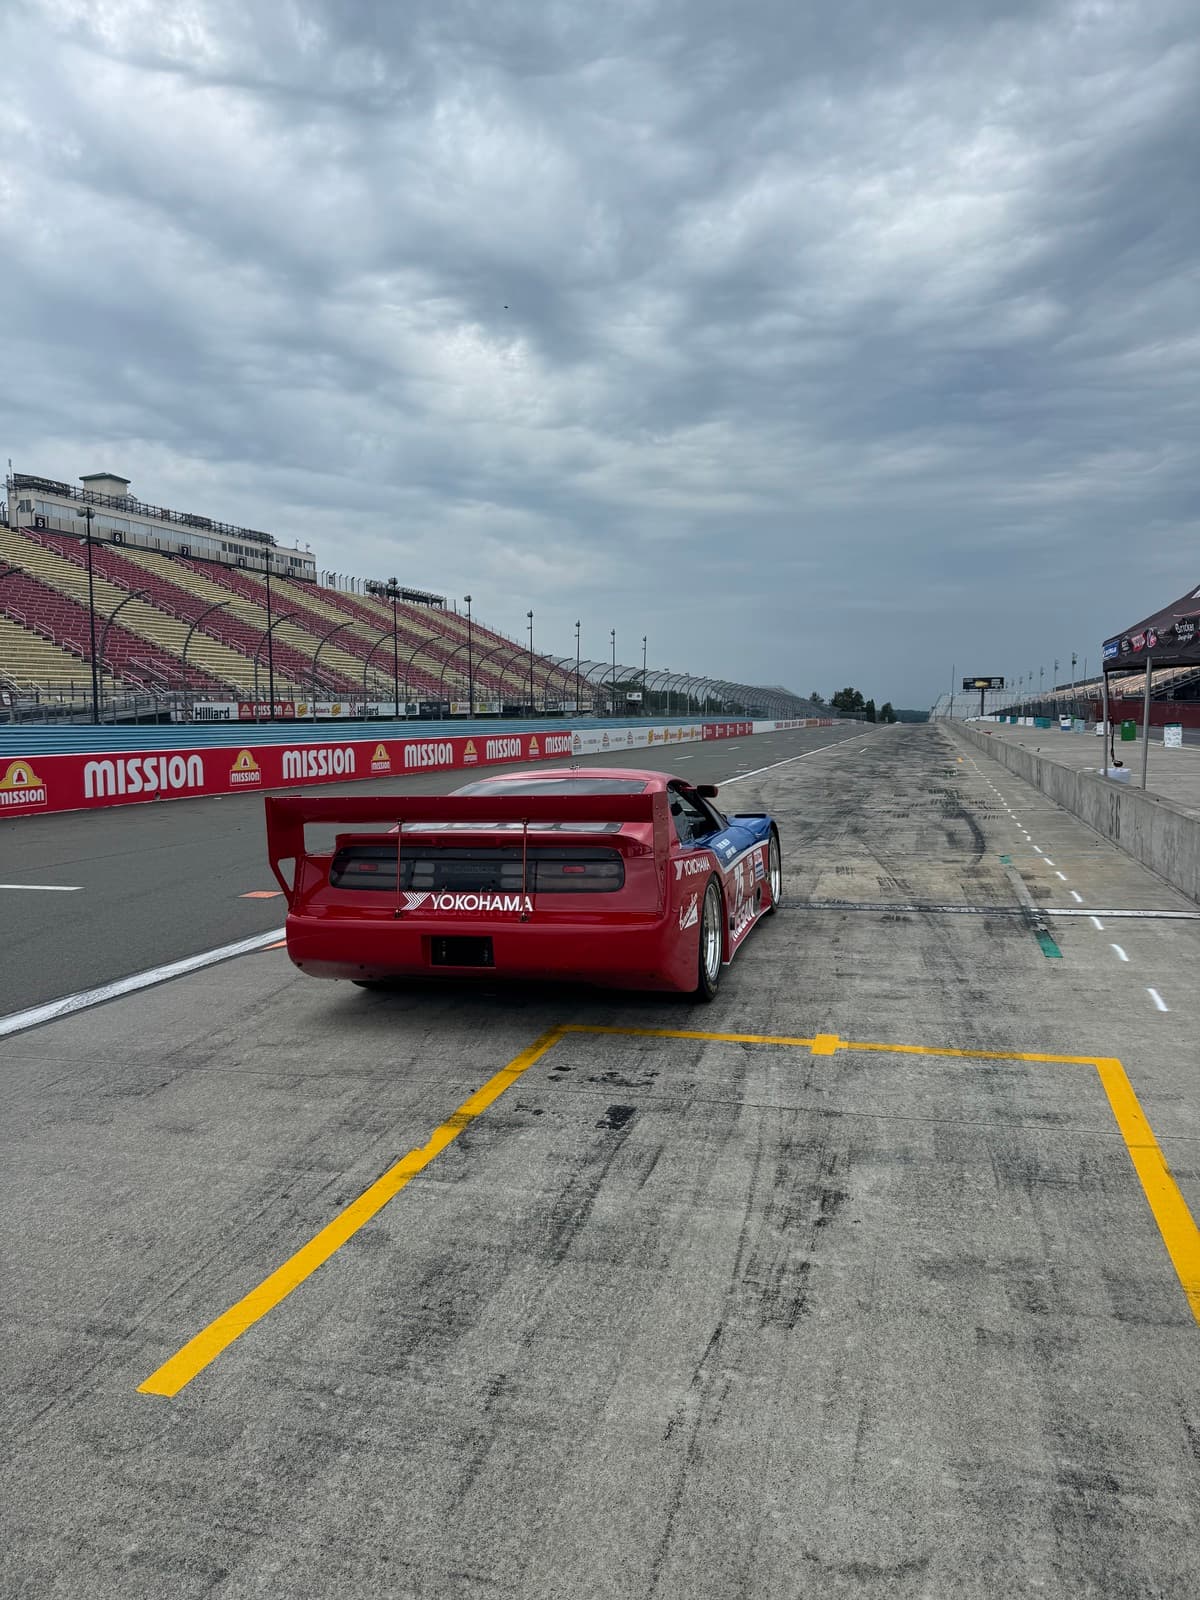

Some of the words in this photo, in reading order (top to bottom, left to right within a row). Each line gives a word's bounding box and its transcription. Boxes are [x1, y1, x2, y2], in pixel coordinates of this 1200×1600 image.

[38, 518, 44, 528] 5
[115, 534, 121, 542] 6
[195, 707, 229, 720] Hilliard
[253, 705, 283, 716] MISSON
[358, 706, 379, 716] Hiiard
[486, 738, 521, 760] MISSION
[544, 736, 572, 754] MISSION
[282, 748, 355, 779] MISSION
[404, 743, 453, 768] MISSION
[84, 755, 204, 798] MISSION
[231, 771, 260, 783] MISSION
[684, 856, 711, 876] YOKOHAMA
[431, 894, 533, 912] YOKOHAMA
